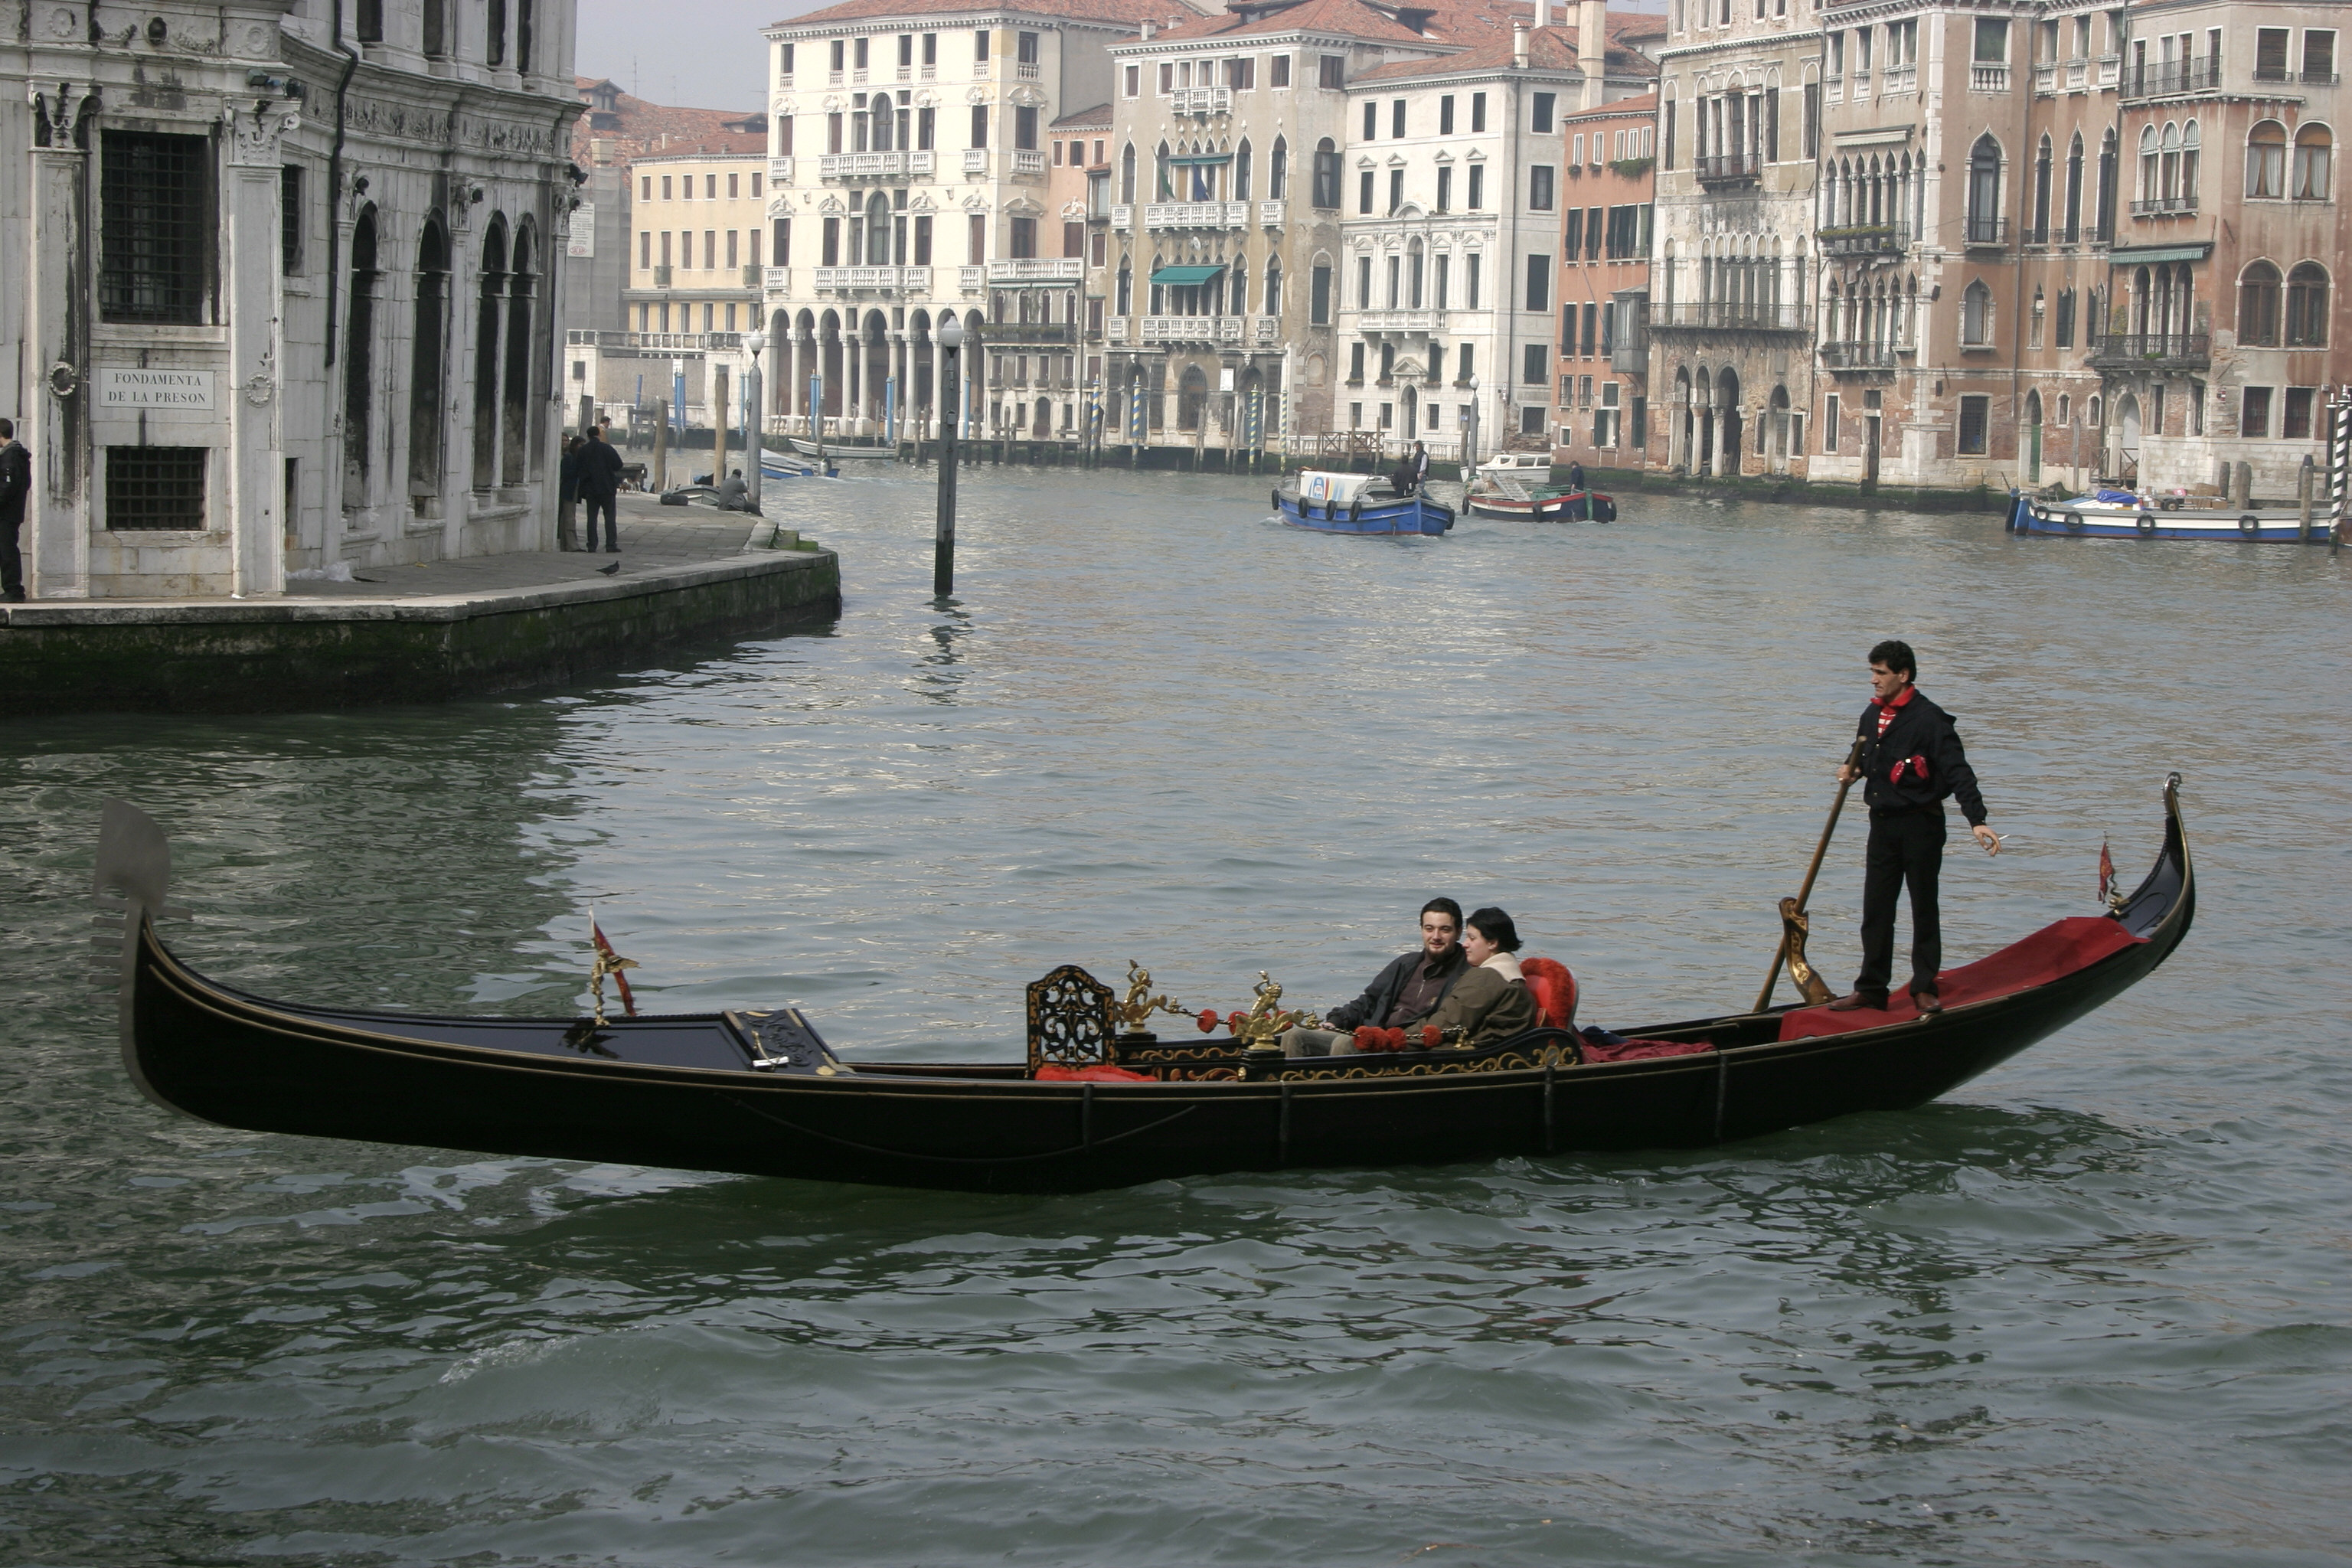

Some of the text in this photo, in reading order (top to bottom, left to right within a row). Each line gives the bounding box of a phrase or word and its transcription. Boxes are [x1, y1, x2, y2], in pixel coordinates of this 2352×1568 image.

[115, 373, 201, 386] FONDAMENTA
[109, 391, 206, 403] DE LA PRESON
